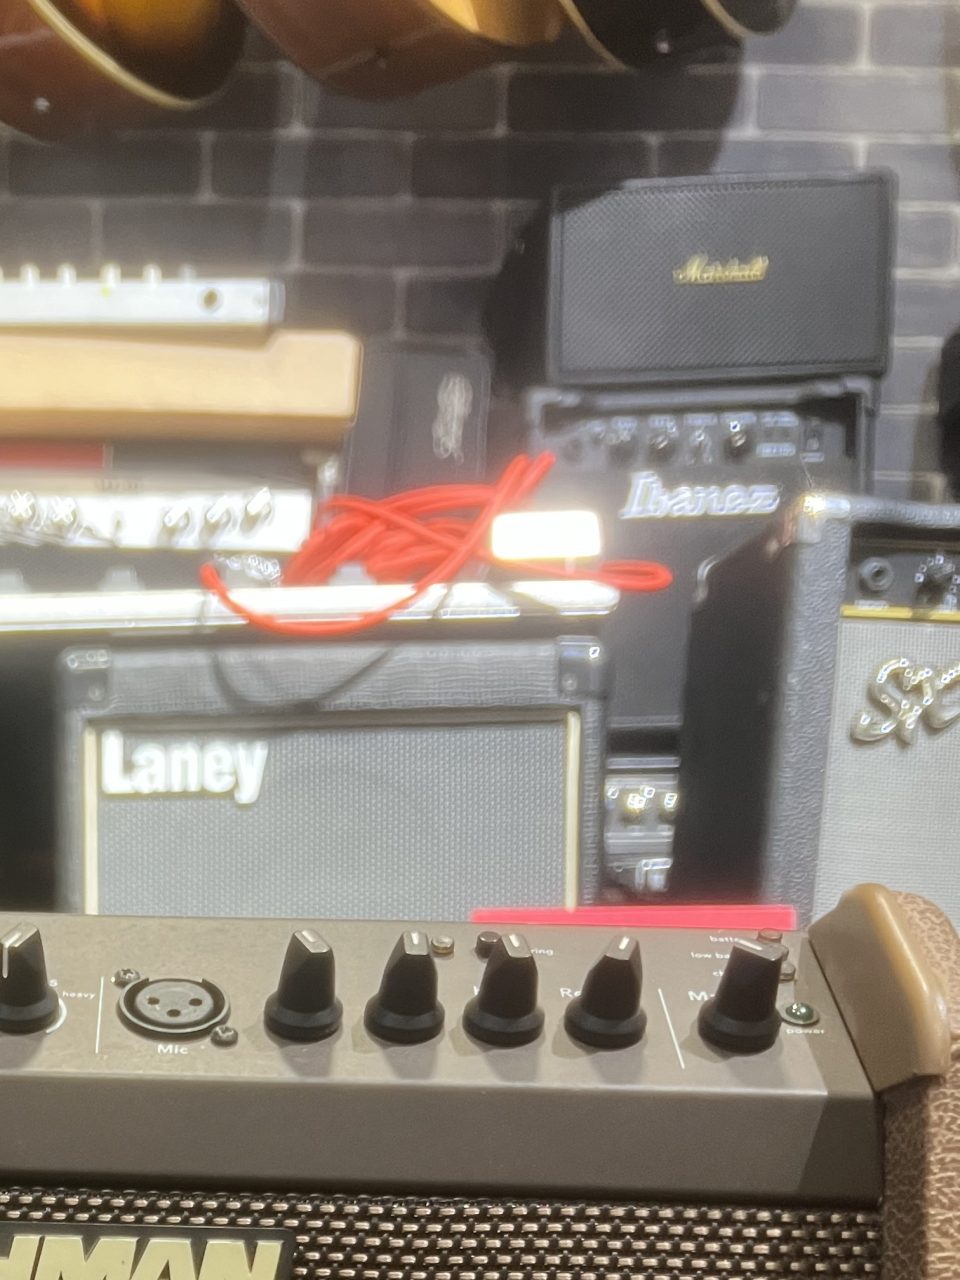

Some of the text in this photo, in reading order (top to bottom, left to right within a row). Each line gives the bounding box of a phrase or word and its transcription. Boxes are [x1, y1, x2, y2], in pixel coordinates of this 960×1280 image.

[619, 470, 780, 519] Ibanez
[101, 729, 269, 805] Laney
[62, 990, 96, 1000] heavy
[157, 1044, 190, 1055] Mic
